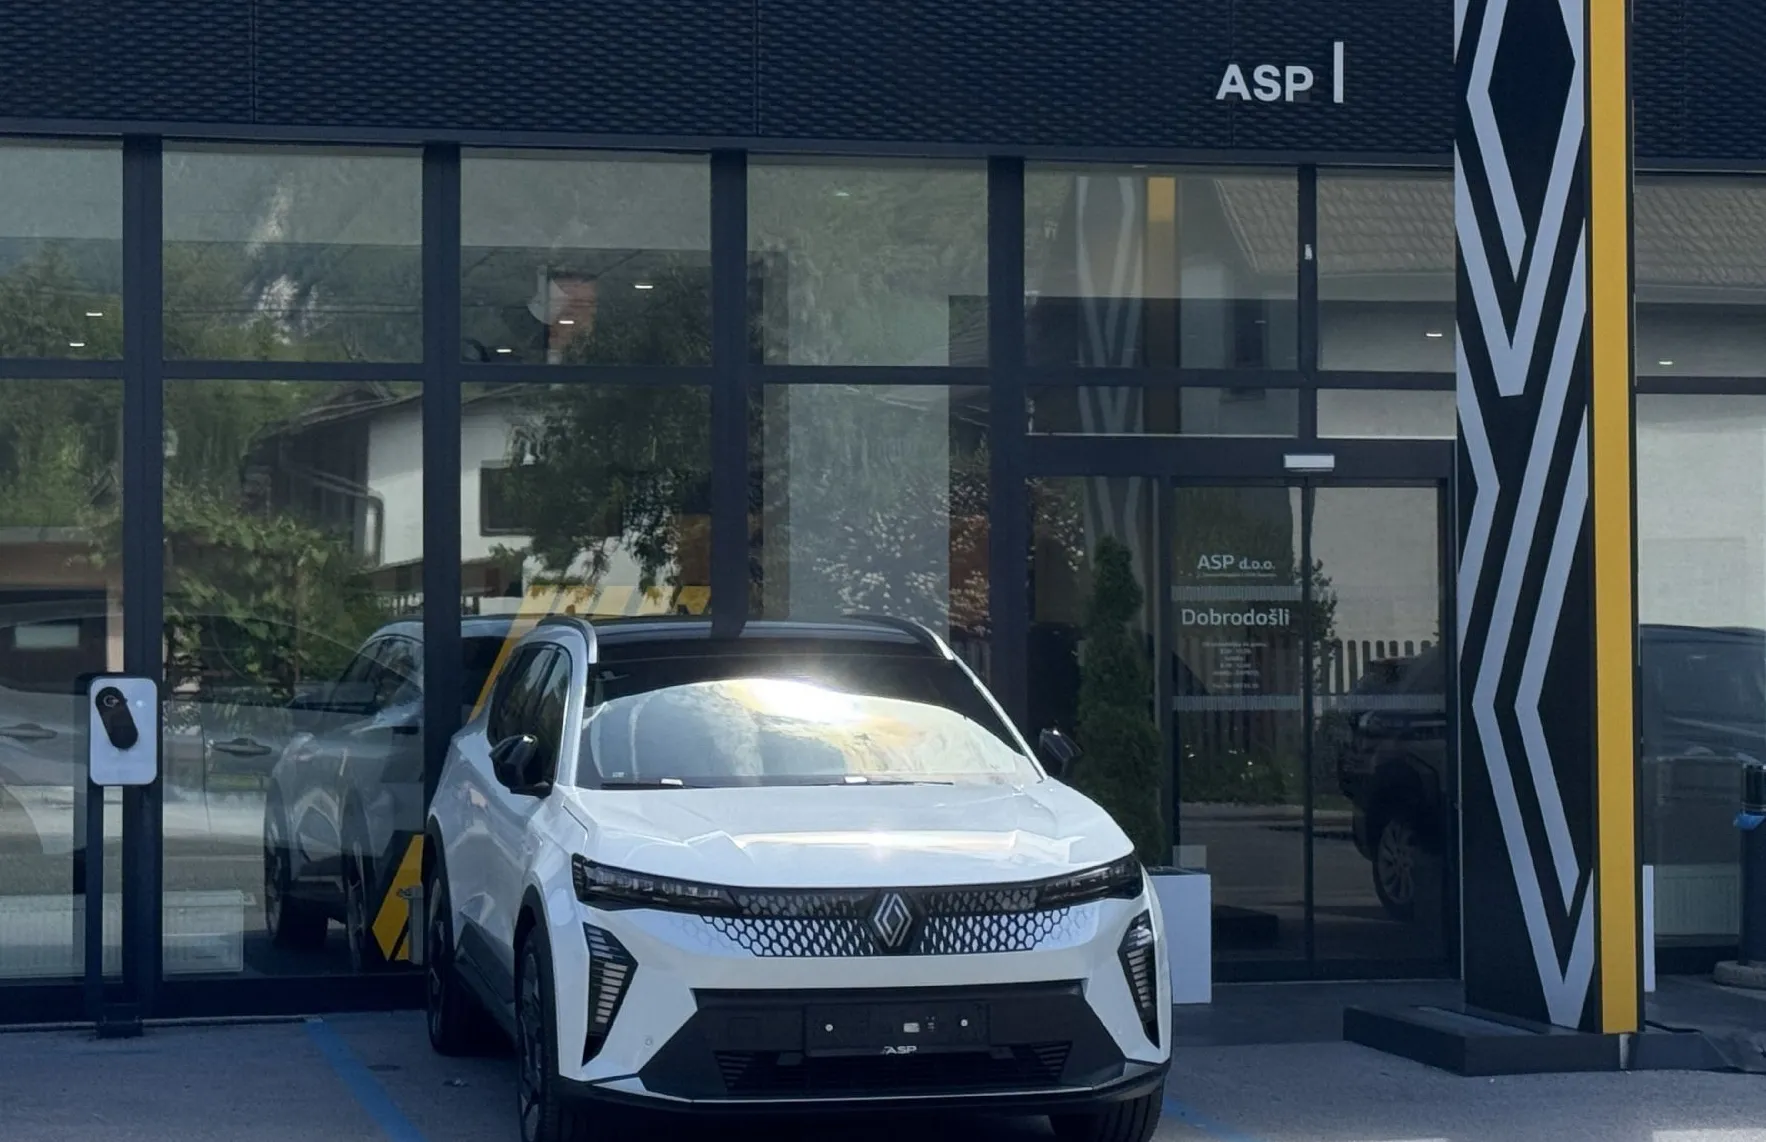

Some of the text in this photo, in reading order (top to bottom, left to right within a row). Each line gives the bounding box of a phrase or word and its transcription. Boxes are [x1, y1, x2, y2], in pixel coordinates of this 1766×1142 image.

[1215, 63, 1314, 102] ASP
[1197, 554, 1276, 570] ASP d.o.o.
[1181, 608, 1290, 626] Dobrodošli
[882, 1045, 917, 1054] ASP
